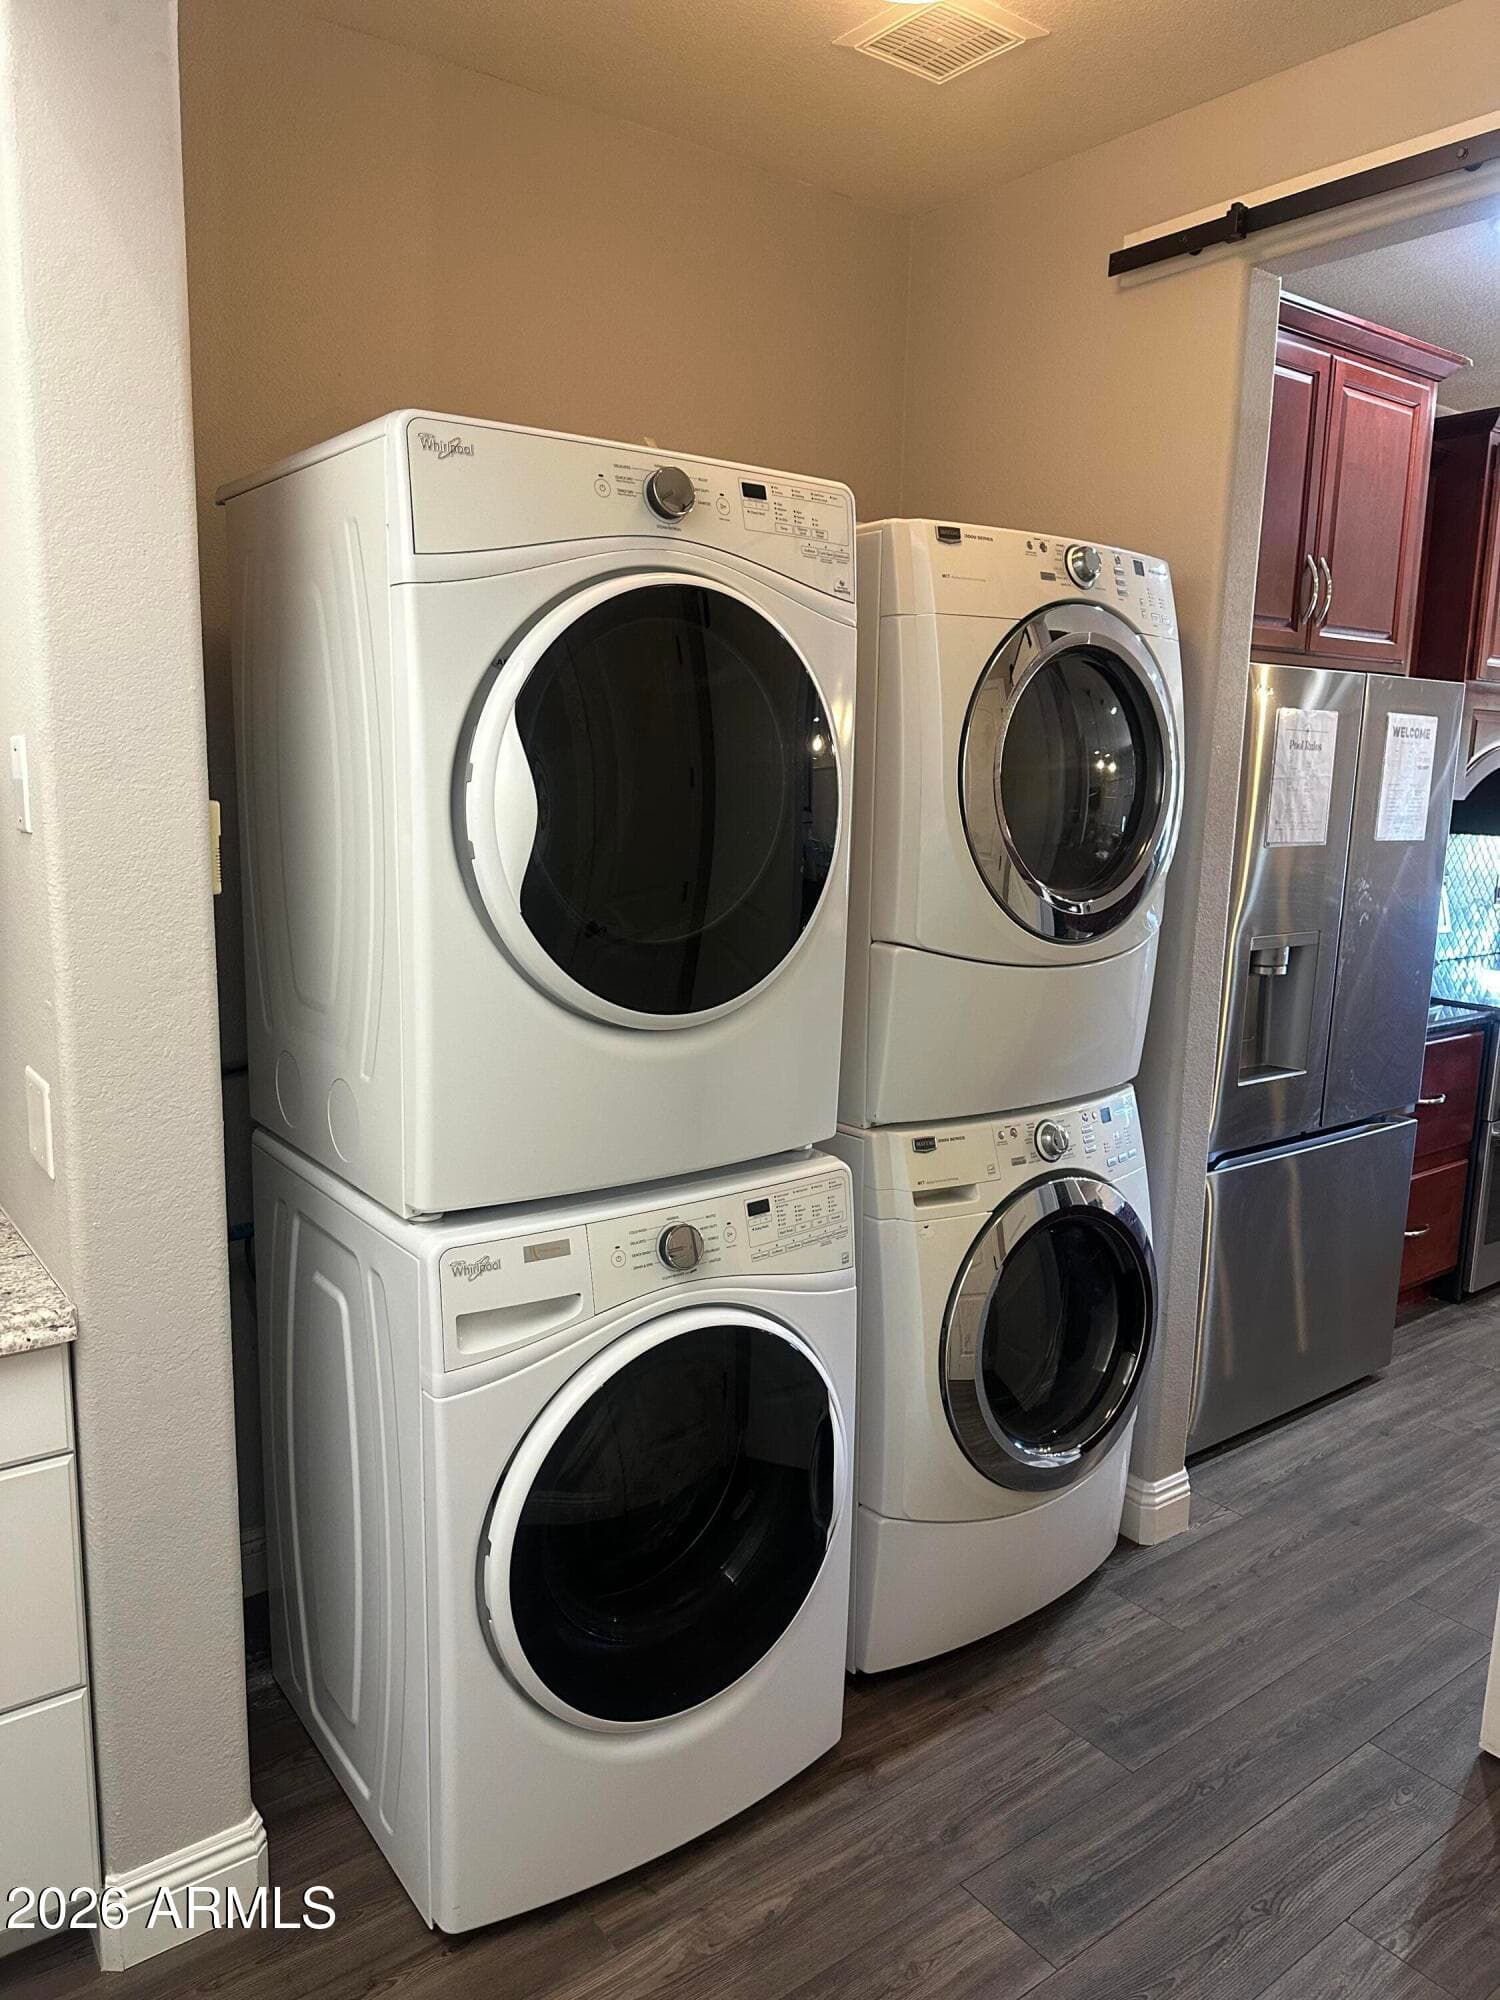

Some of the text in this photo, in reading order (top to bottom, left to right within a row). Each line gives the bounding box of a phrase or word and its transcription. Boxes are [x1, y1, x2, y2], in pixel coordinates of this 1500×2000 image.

[419, 435, 474, 458] Whirlpool
[1393, 726, 1431, 740] WELCOME
[450, 1257, 501, 1280] Whirlpool
